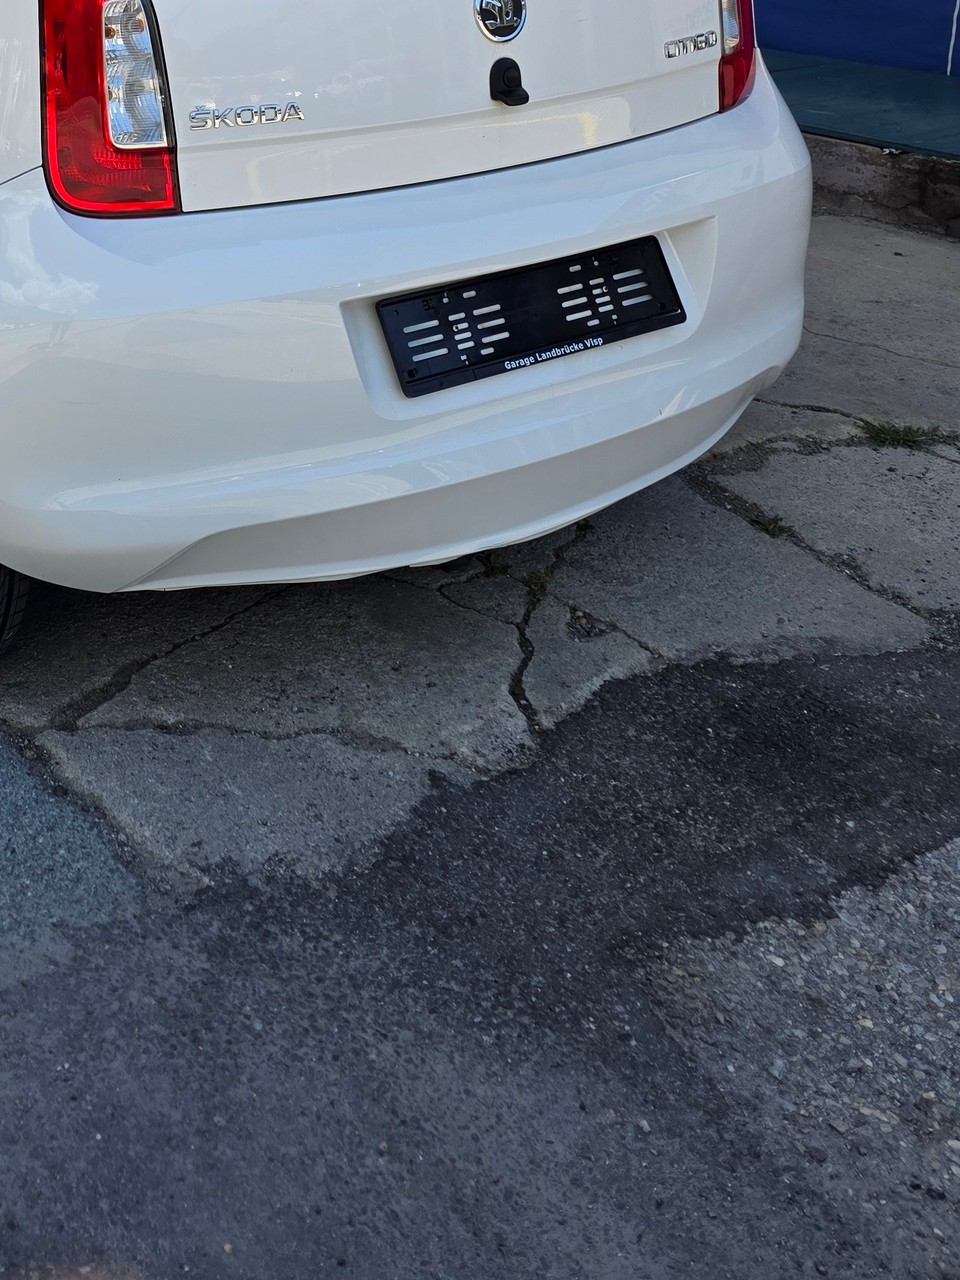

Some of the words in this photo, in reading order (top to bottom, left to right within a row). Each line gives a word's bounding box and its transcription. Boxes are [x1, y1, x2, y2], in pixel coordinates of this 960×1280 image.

[189, 102, 305, 131] ŠKODA
[504, 355, 535, 370] Garage
[536, 342, 585, 361] Landbrücke
[584, 337, 604, 348] Visp
